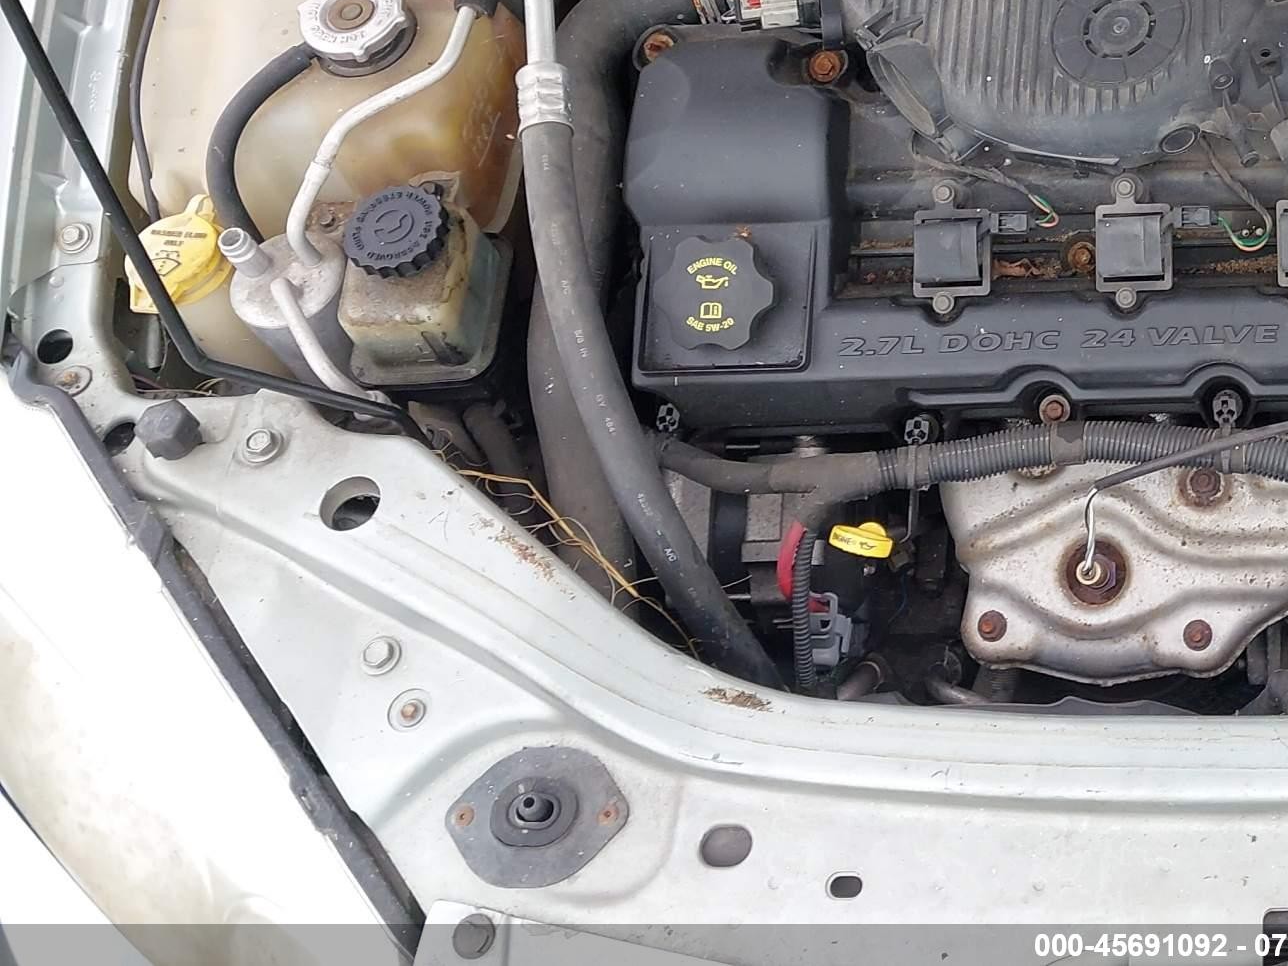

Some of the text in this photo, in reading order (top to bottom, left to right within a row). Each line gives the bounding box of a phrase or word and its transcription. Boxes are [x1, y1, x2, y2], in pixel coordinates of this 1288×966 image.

[687, 257, 738, 275] ENGINE OIL
[686, 316, 735, 332] SAE 5W-20
[839, 323, 1279, 357] 2.7L DOHC 24 VALVE
